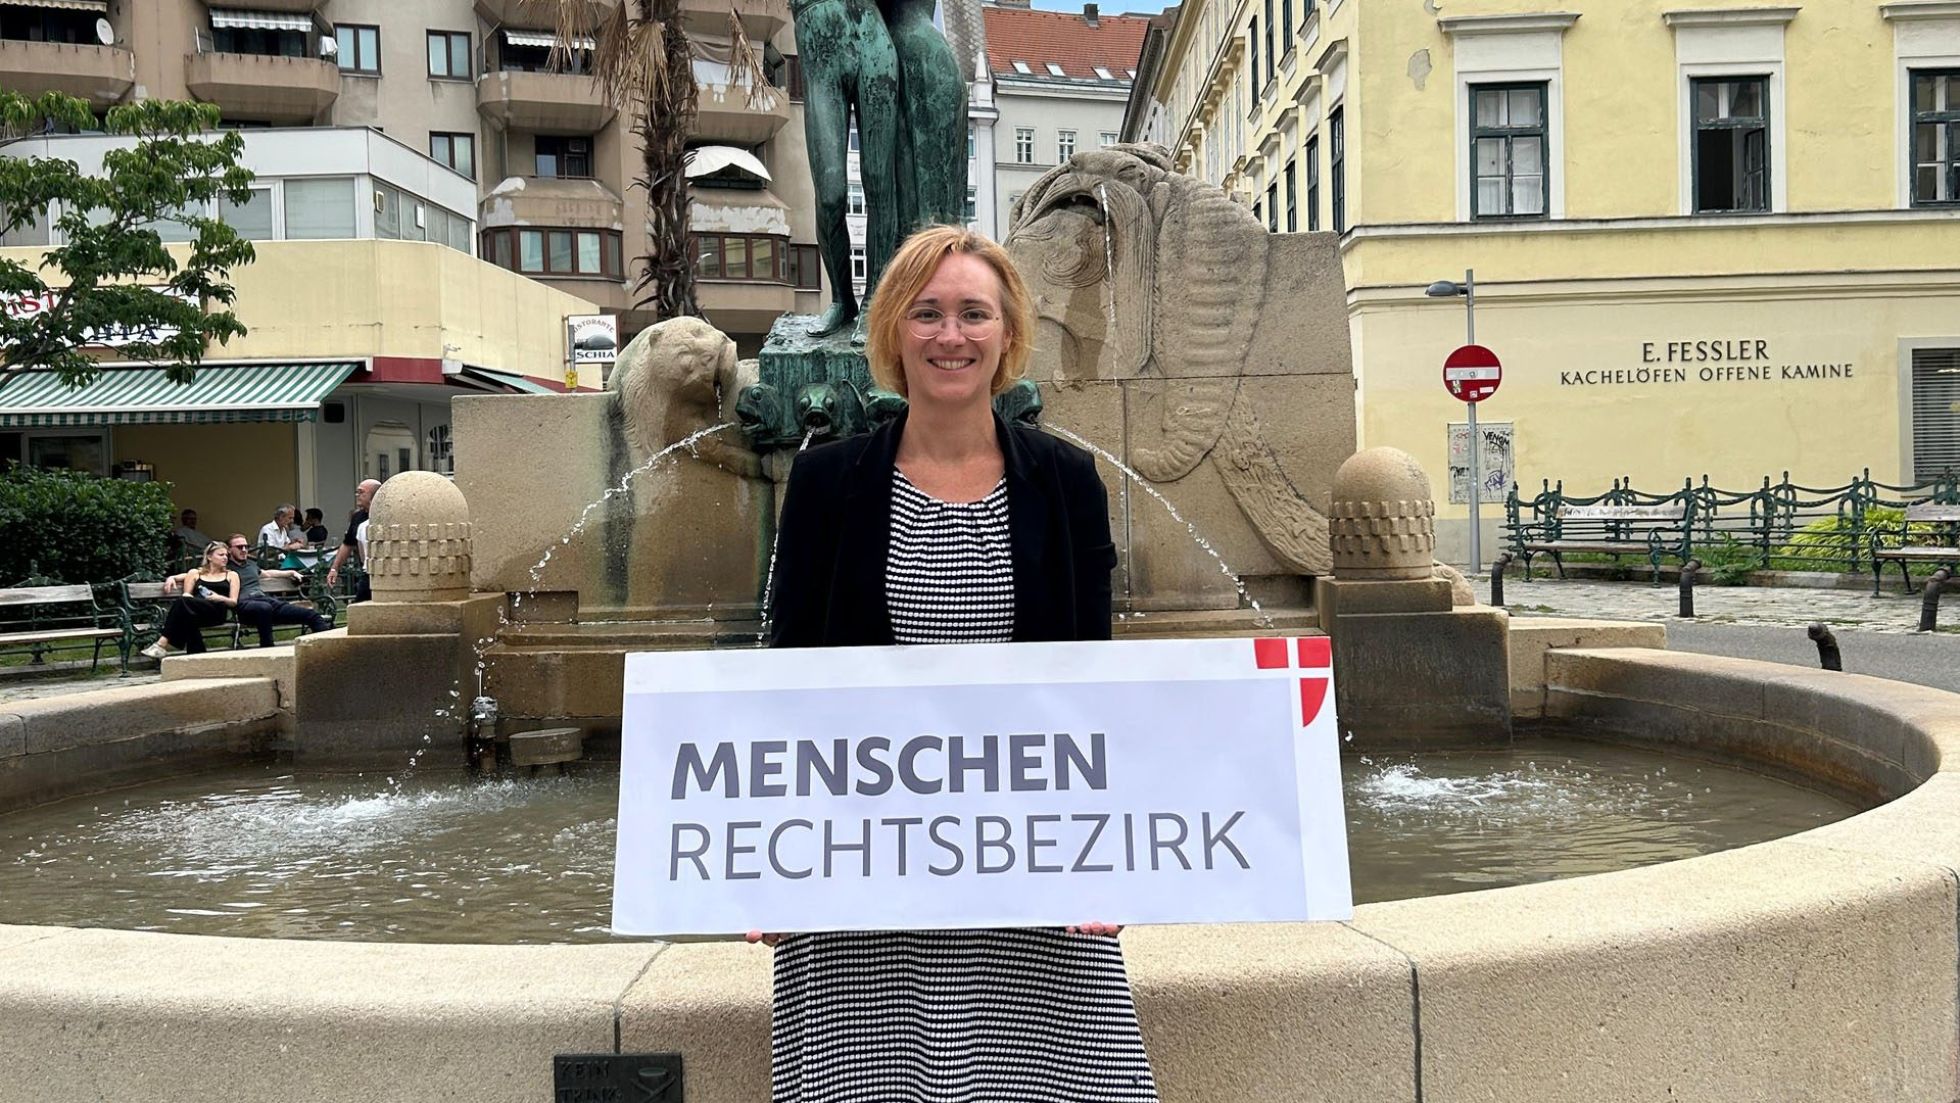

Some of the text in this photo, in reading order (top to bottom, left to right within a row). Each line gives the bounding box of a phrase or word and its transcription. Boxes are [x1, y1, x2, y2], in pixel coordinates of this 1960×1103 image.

[574, 319, 614, 333] ISTORANTE
[576, 351, 615, 359] SCHIA
[1643, 340, 1769, 363] E. FESSLER
[1561, 365, 1854, 385] KACHELÖFEN OFFENE KAMINE
[671, 733, 1108, 800] MENSCHEN
[669, 811, 1252, 881] RECHTSBEZIRK
[560, 1061, 609, 1078] KEIN
